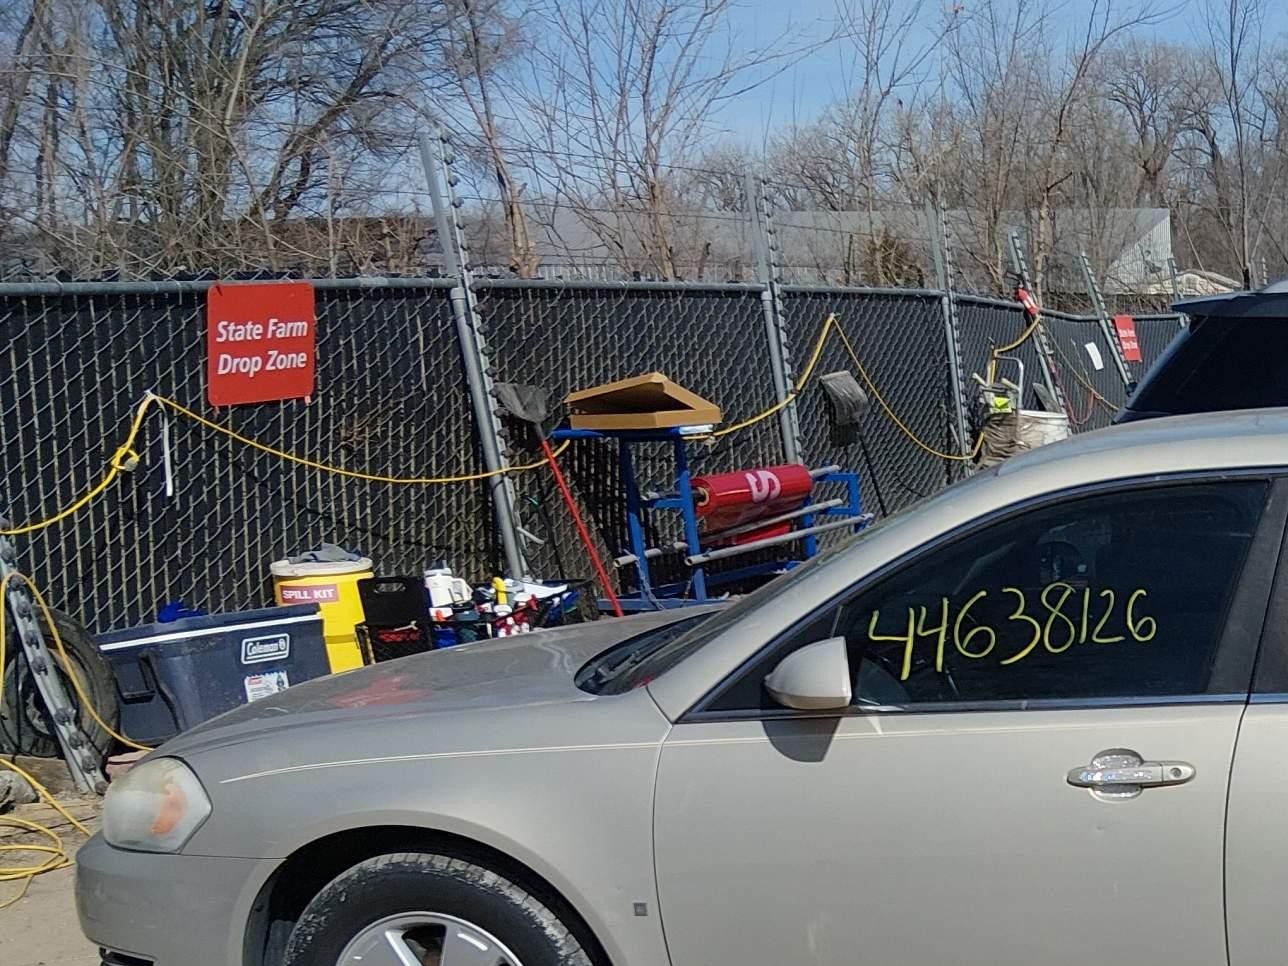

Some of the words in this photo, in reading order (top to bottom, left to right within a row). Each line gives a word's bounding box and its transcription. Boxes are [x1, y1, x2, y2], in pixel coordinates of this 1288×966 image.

[216, 321, 263, 342] State
[267, 318, 308, 339] Farm
[217, 353, 262, 378] Drop
[265, 350, 307, 371] Zone
[282, 590, 312, 600] SPILL
[313, 588, 336, 599] KIT
[868, 582, 1157, 681] 44638126
